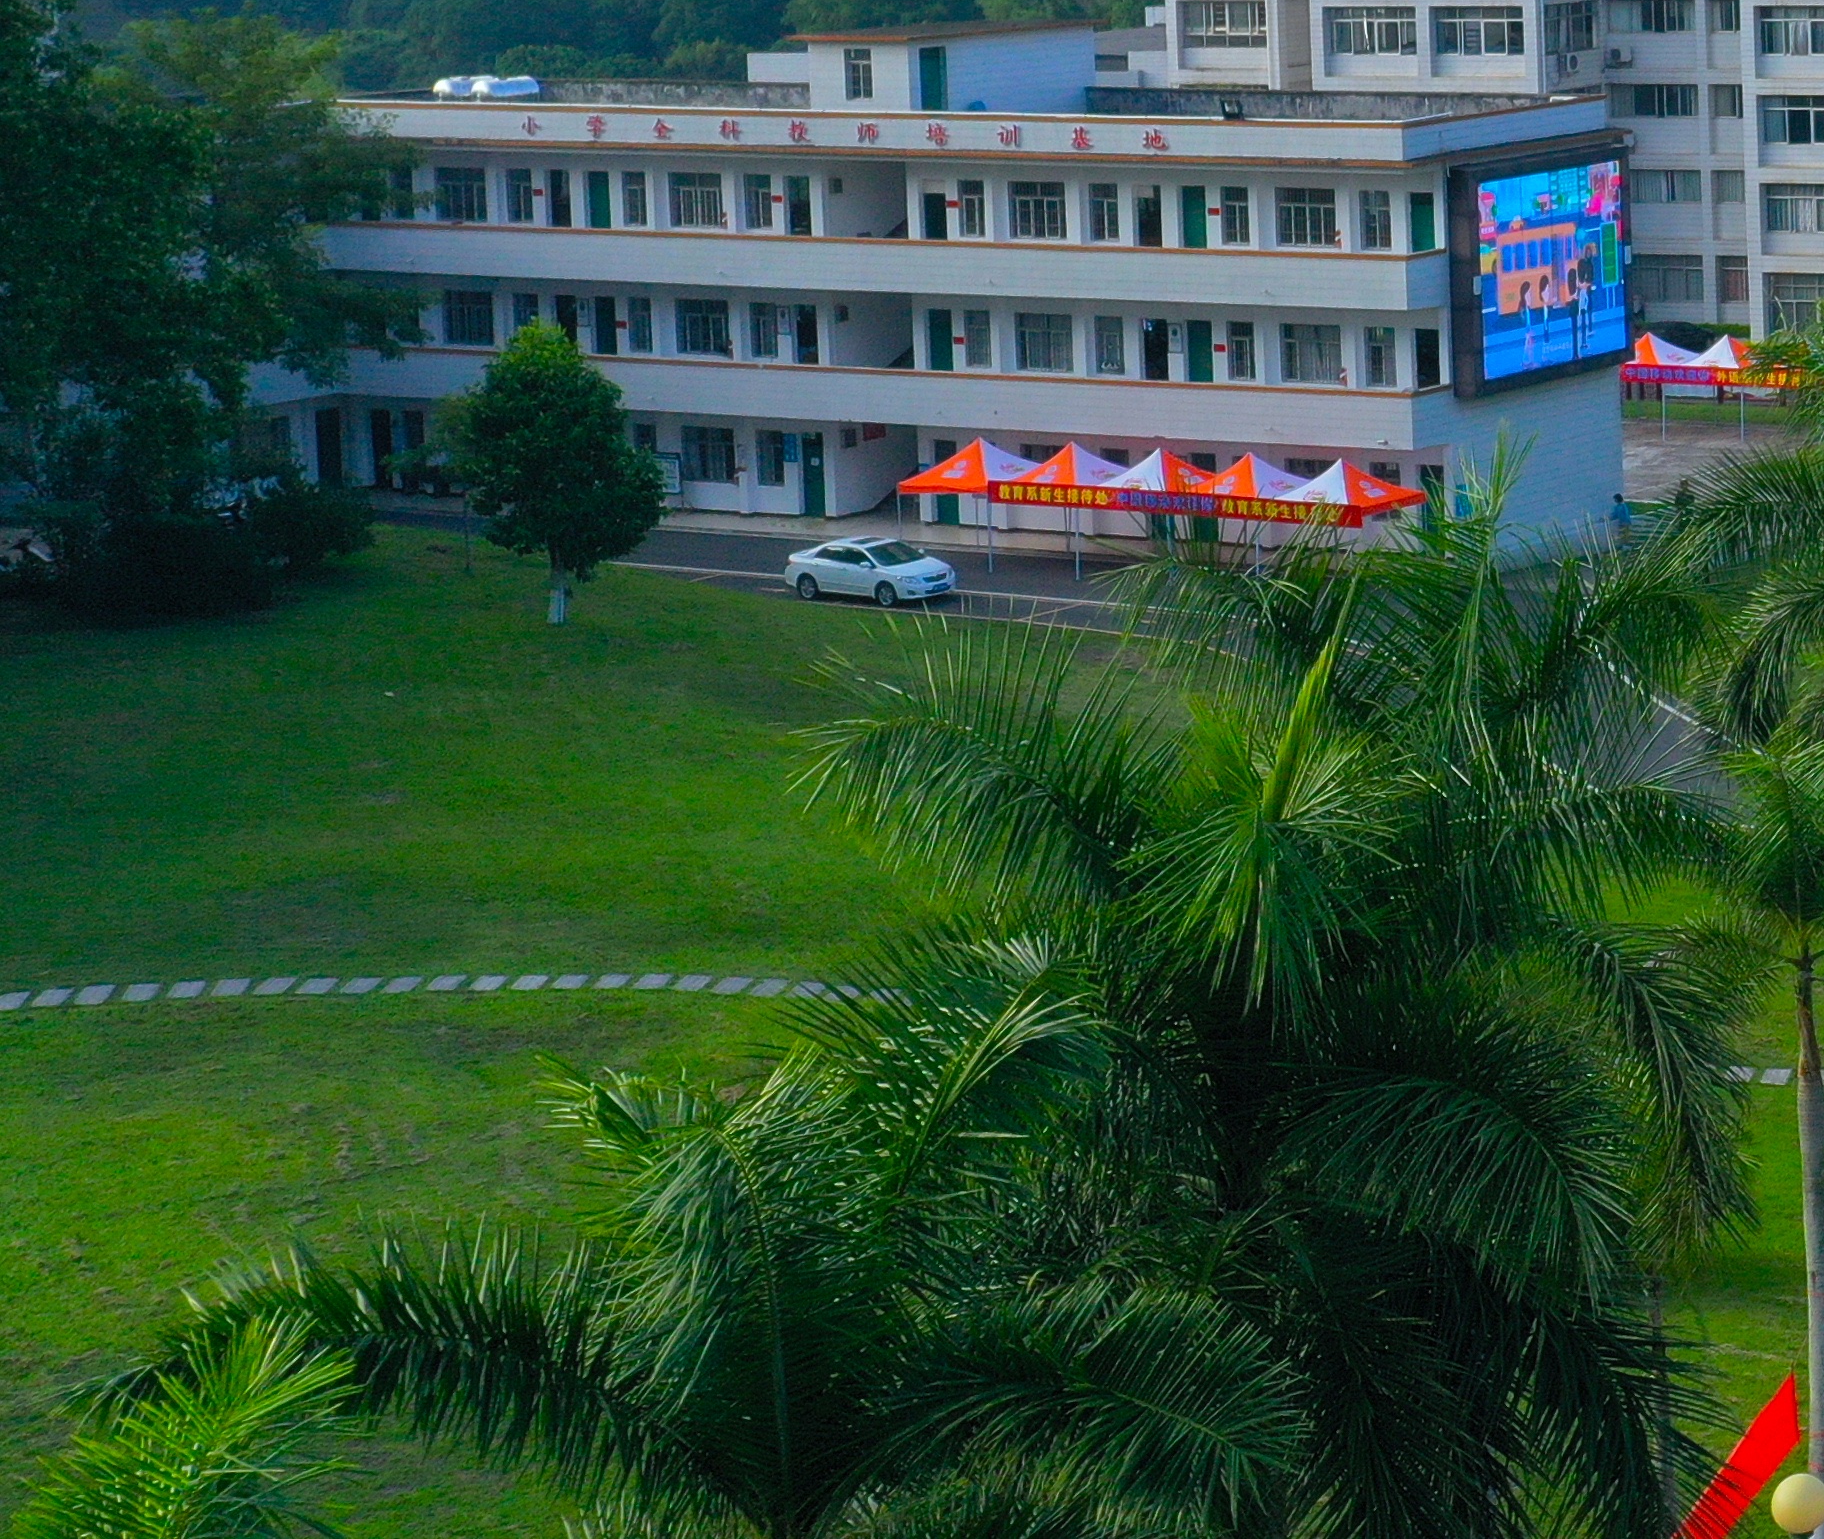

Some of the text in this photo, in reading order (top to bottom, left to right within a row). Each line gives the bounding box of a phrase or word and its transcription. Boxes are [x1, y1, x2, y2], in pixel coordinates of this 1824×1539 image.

[520, 115, 1168, 150] 小学全科教师培训基地
[999, 484, 1109, 506] 教育系新生接待处
[1222, 497, 1339, 522] 教育系新生接处
